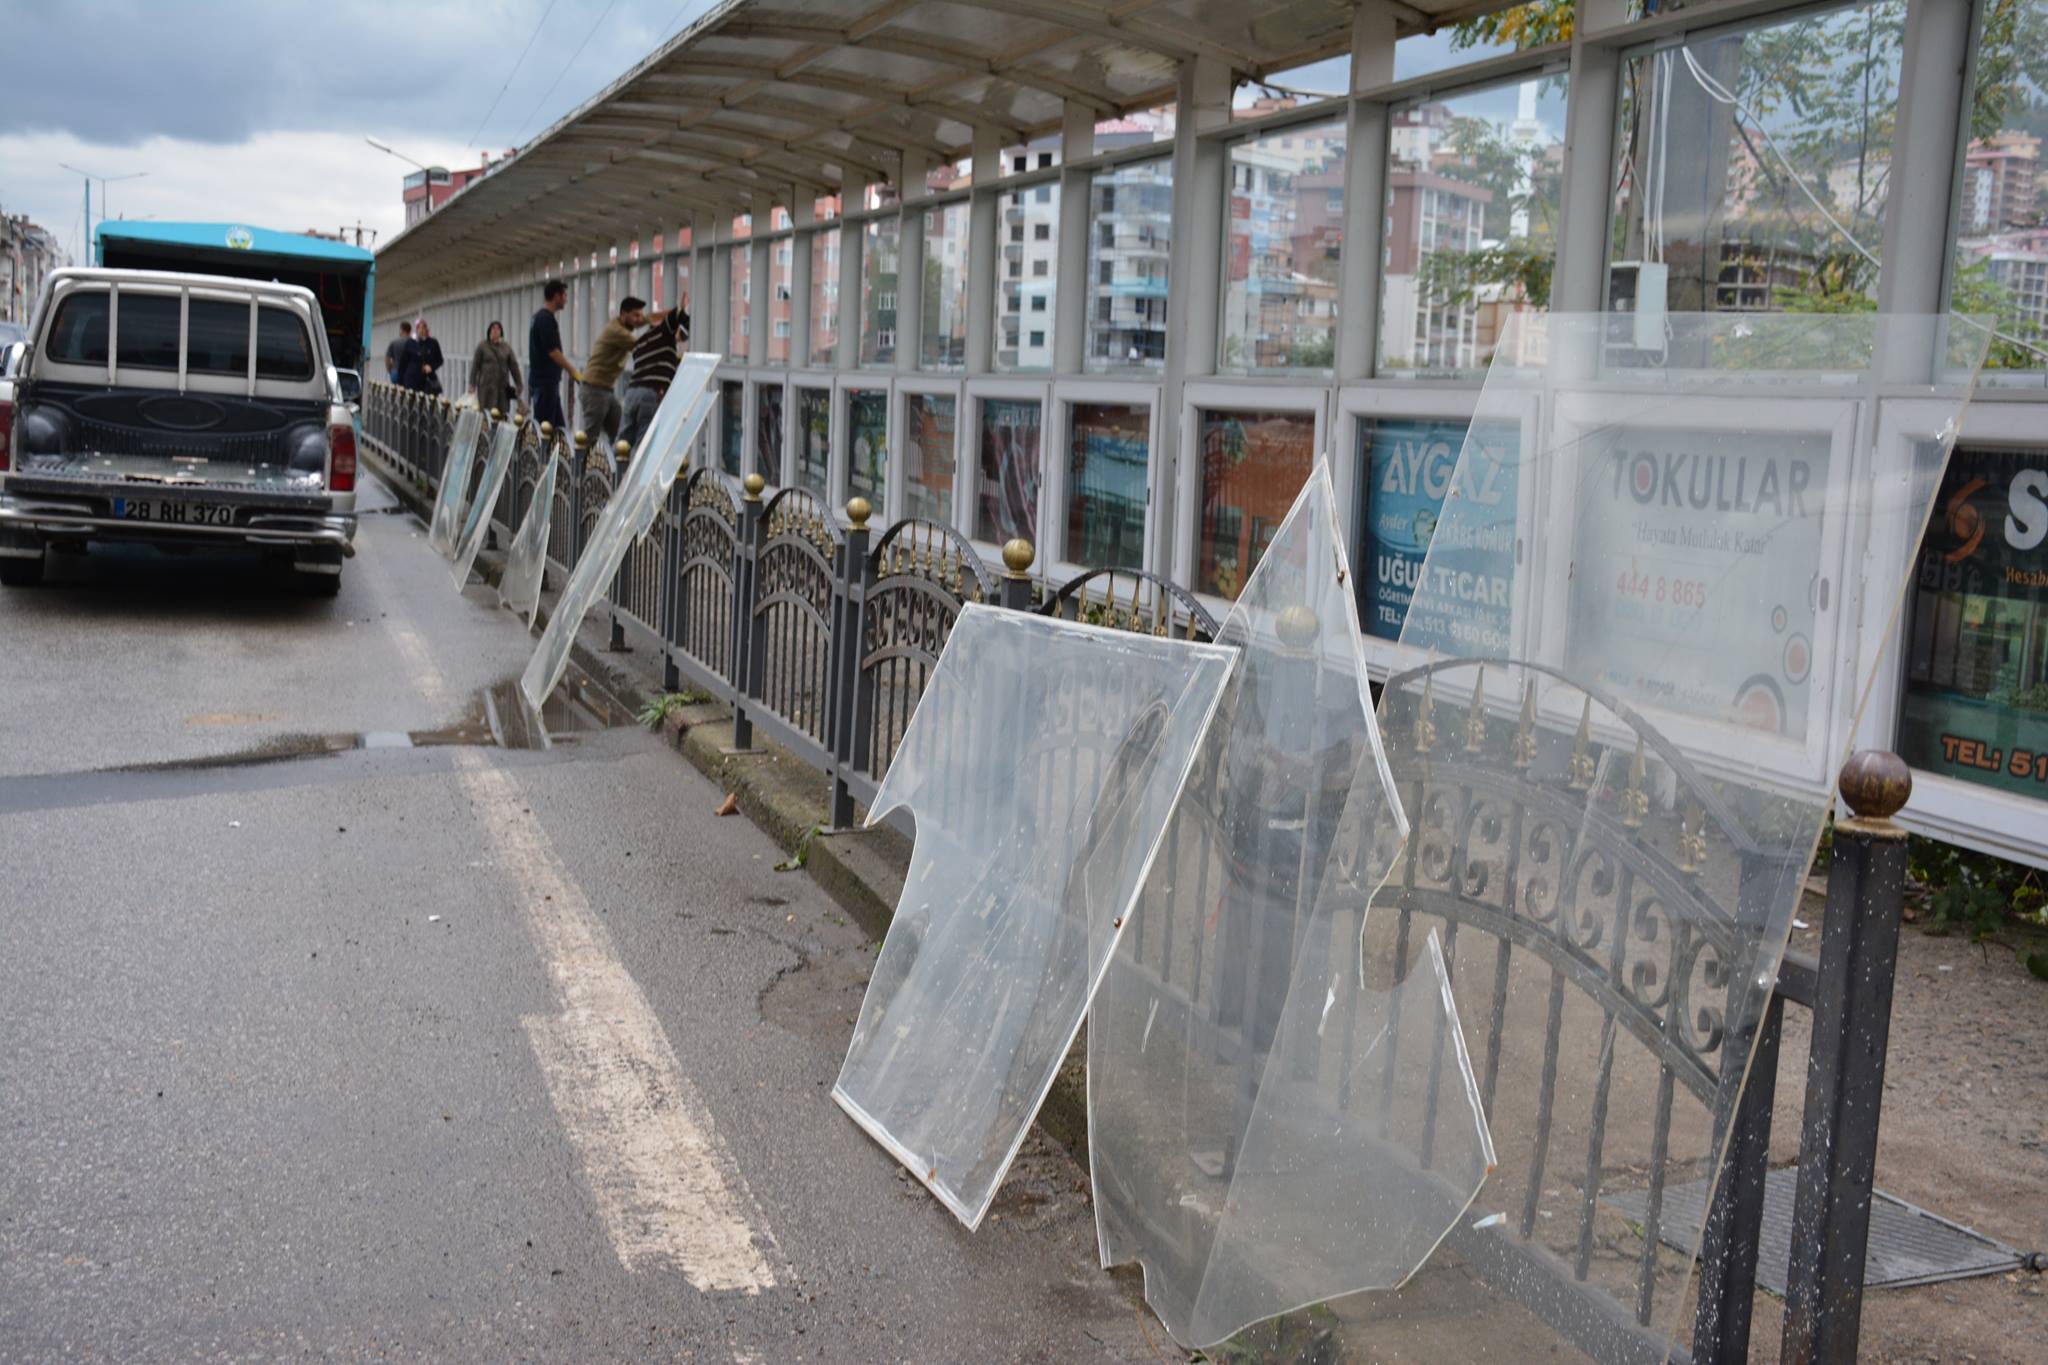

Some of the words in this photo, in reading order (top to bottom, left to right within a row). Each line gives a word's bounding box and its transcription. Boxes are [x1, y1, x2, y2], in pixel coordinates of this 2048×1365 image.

[1381, 440, 1505, 505] AYGAZ
[1612, 450, 1811, 517] TOKULLAR
[126, 502, 150, 518] 28
[160, 502, 186, 521] RH
[1617, 571, 1650, 600] 444
[1656, 576, 1667, 602] 8
[1672, 578, 1706, 610] 865
[1942, 735, 2001, 771] TEL:
